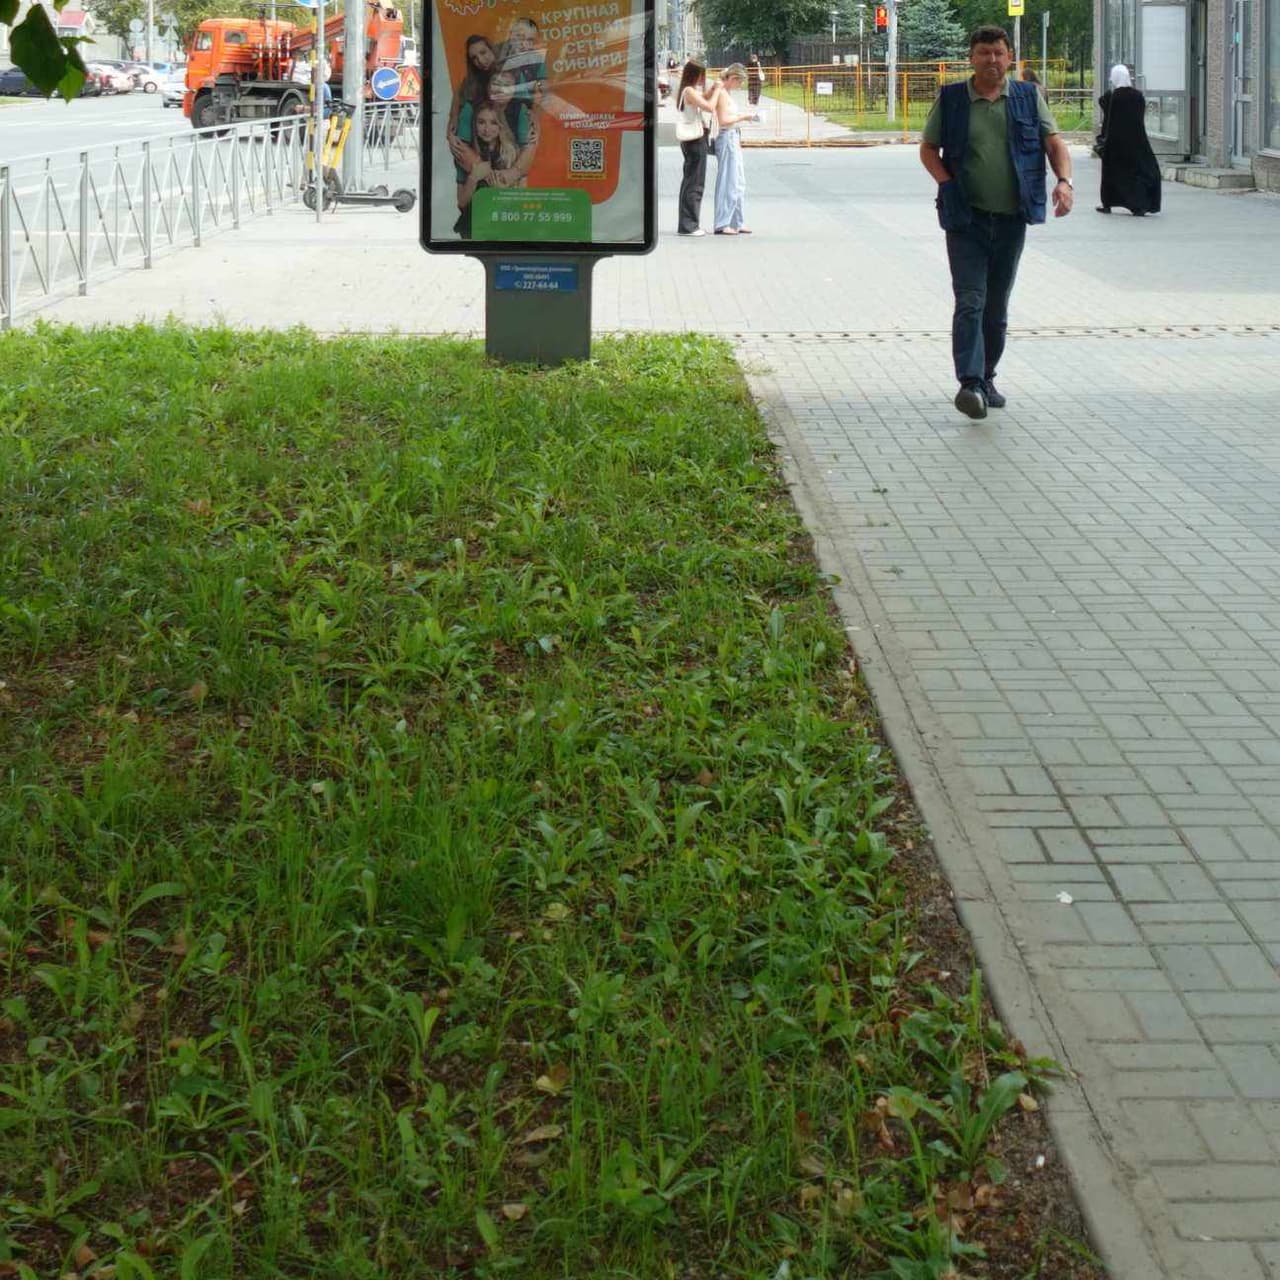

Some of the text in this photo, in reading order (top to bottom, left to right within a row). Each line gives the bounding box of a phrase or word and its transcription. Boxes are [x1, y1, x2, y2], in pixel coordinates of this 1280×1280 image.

[541, 2, 620, 24] КРУПНАЯ
[542, 21, 626, 41] ТОРГОВАЯ
[564, 39, 605, 56] СЕТЬ
